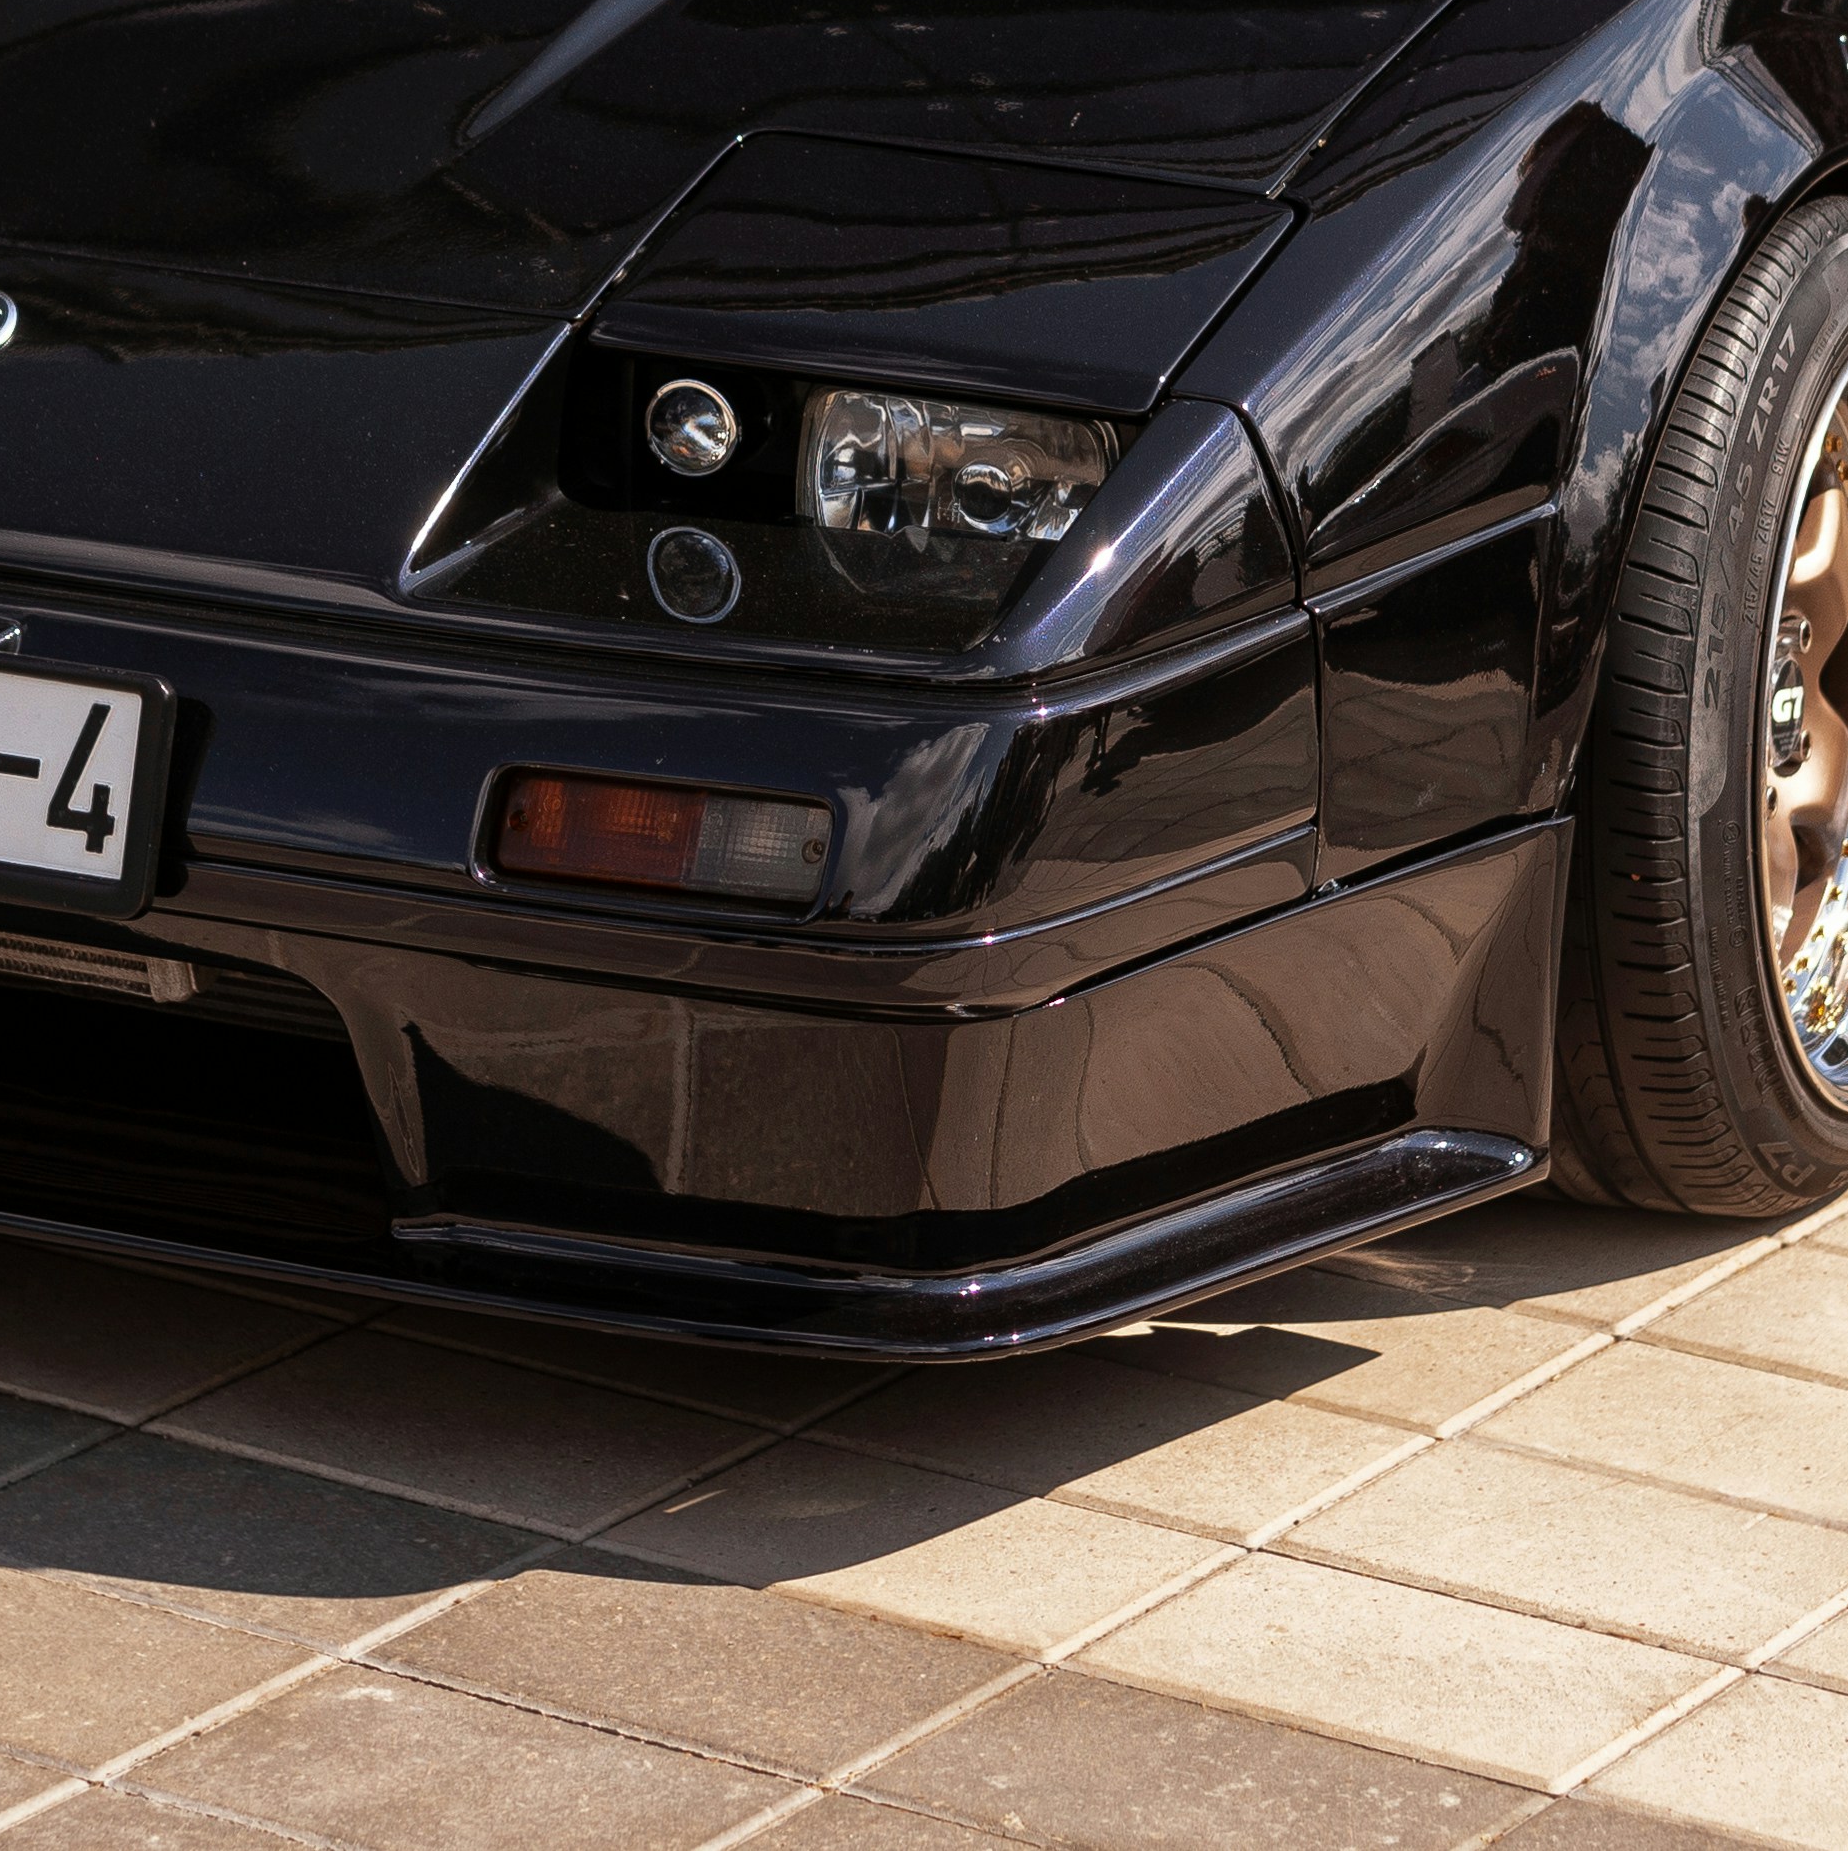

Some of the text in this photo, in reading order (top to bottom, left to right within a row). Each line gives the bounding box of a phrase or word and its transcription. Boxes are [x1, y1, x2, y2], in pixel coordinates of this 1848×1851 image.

[1746, 322, 1796, 453] ZR17
[1754, 499, 1776, 545] ZR17
[1771, 437, 1792, 477] 91W
[1757, 1141, 1816, 1188] P7
